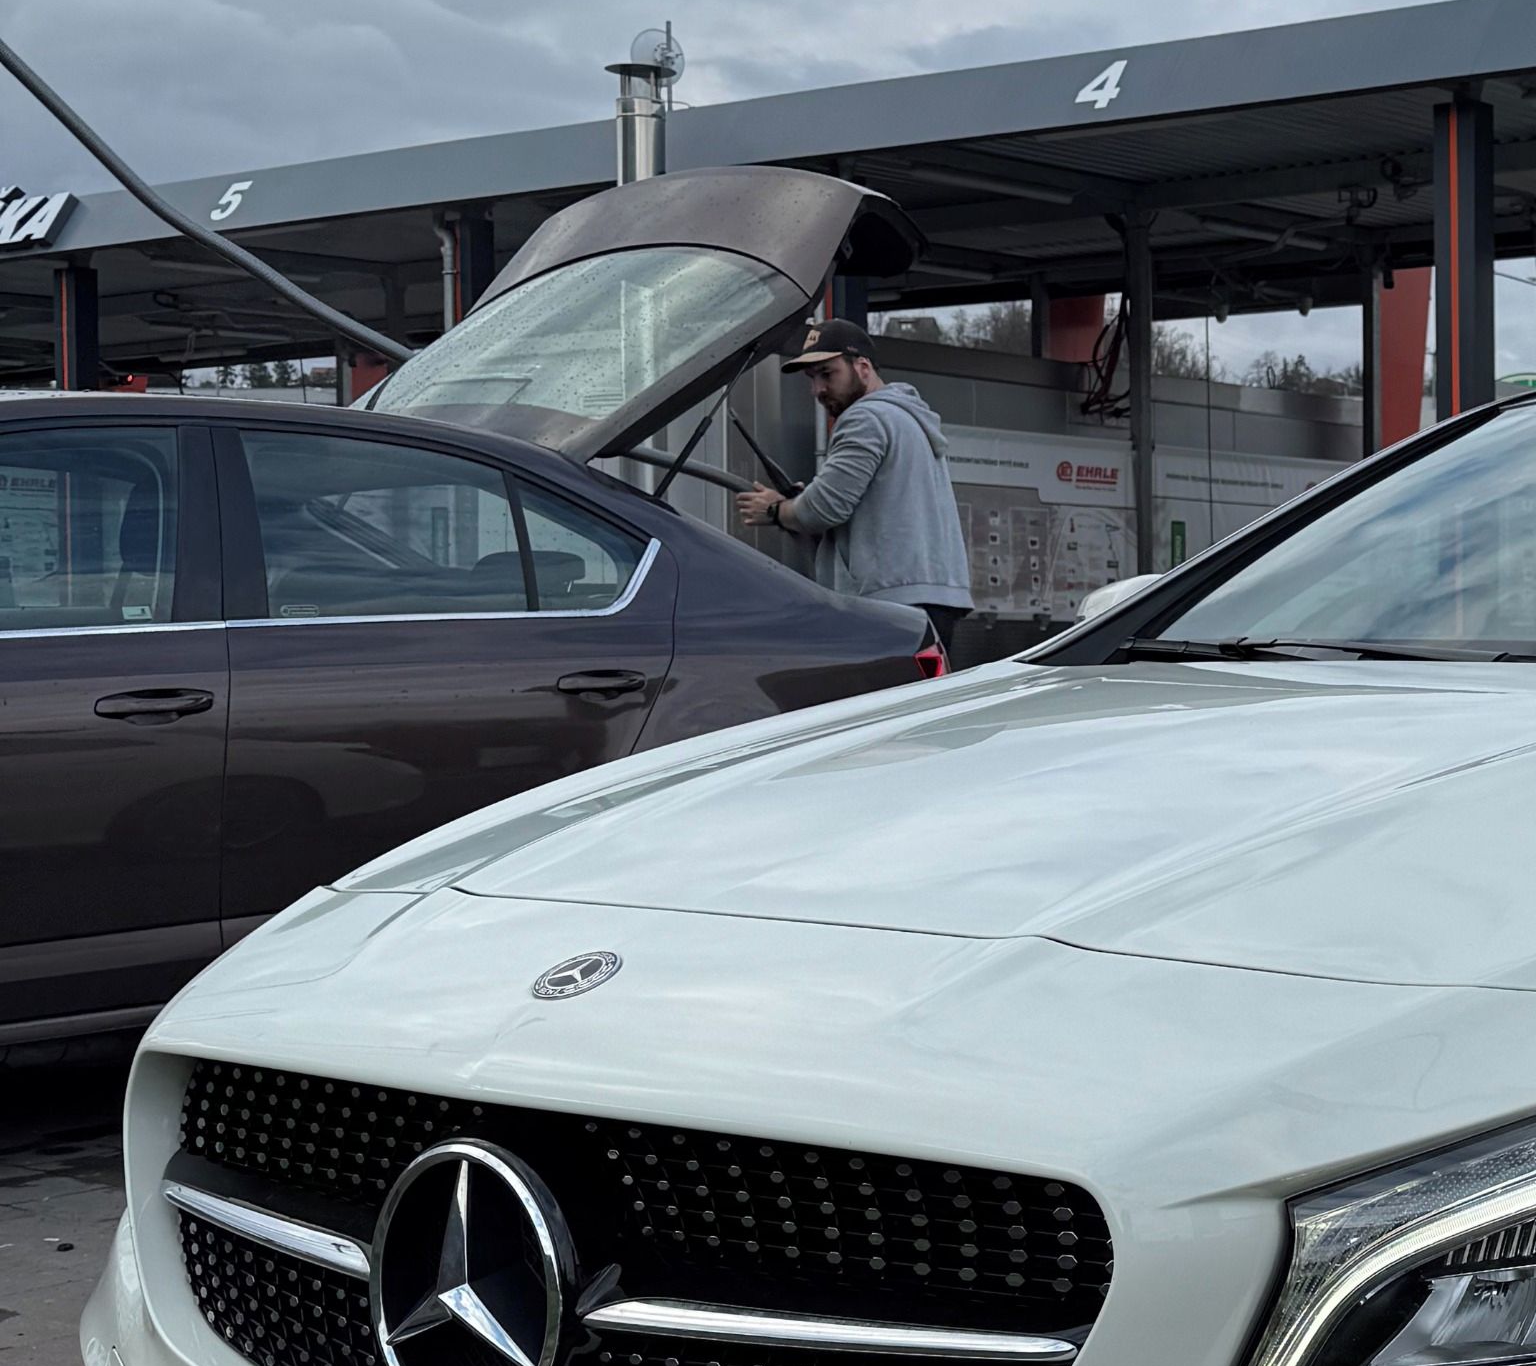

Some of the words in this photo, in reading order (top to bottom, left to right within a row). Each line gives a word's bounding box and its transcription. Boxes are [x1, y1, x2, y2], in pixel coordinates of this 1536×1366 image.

[1075, 59, 1128, 109] 4
[210, 180, 253, 221] 5
[1075, 465, 1119, 480] EHRLE
